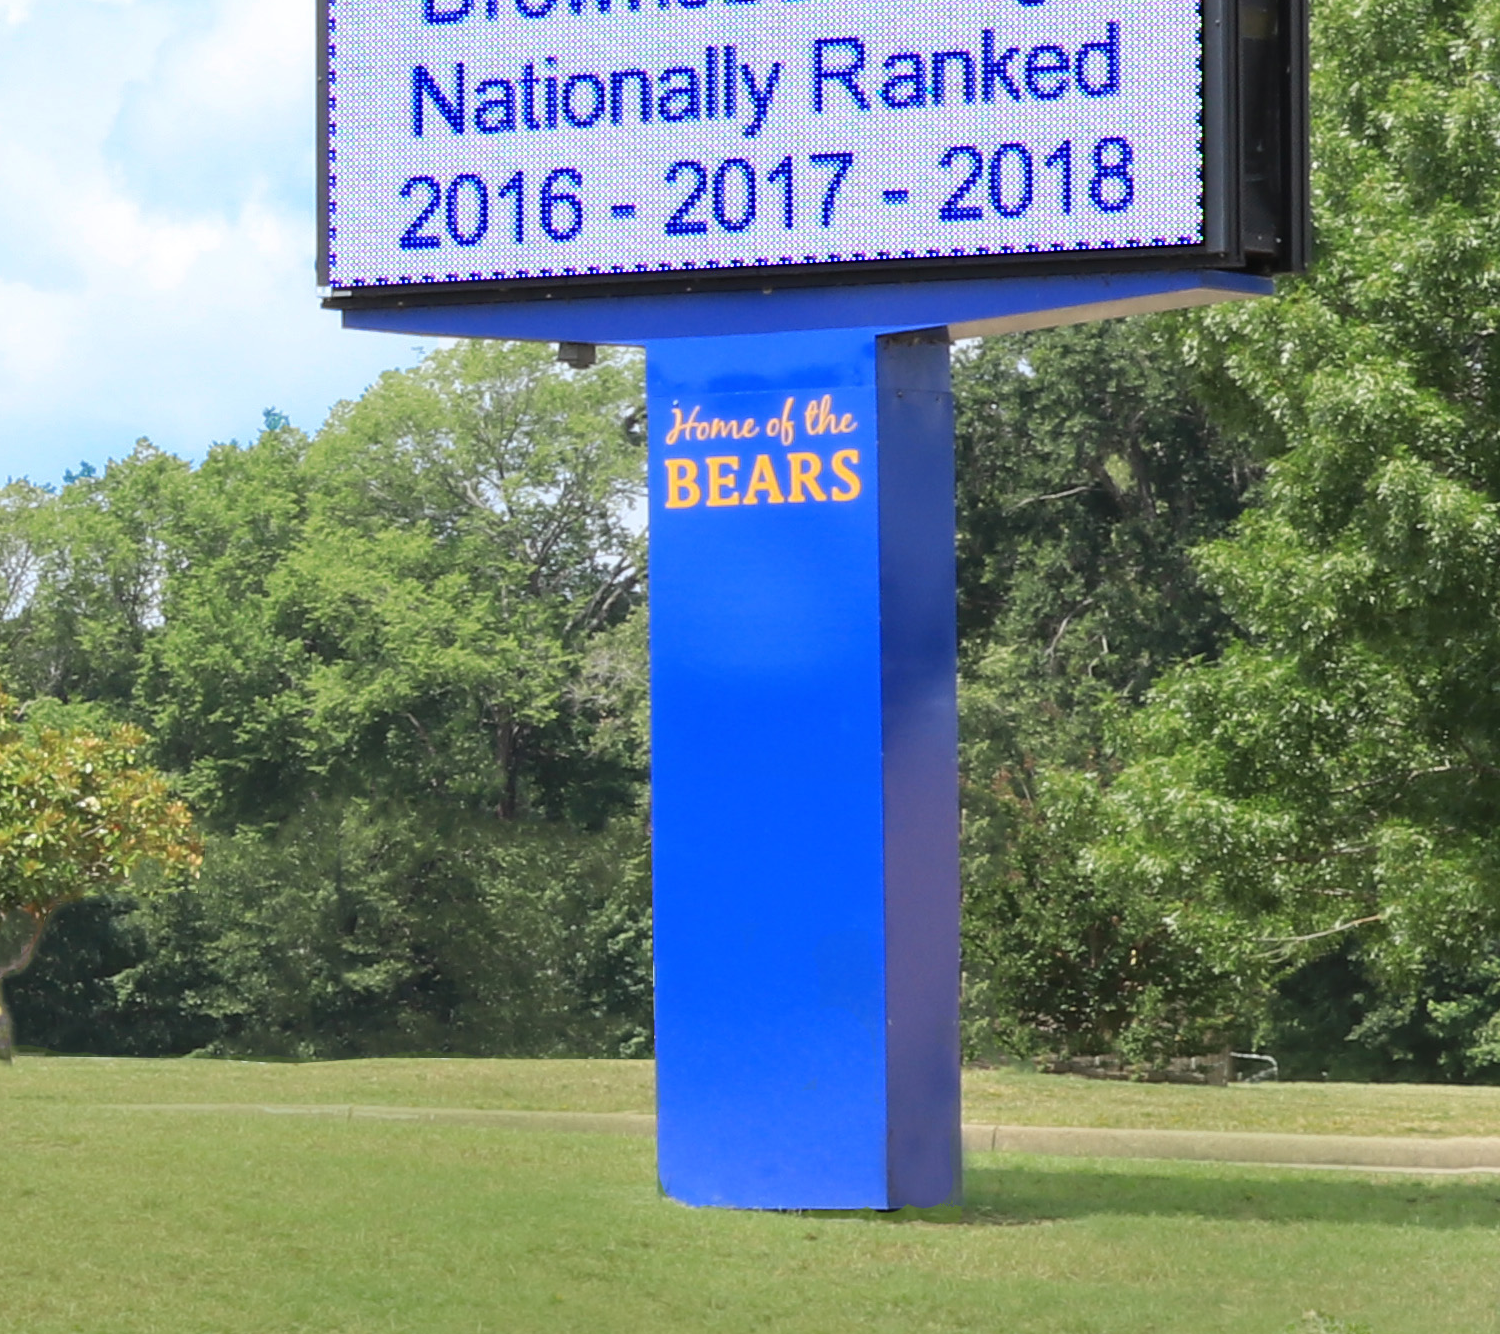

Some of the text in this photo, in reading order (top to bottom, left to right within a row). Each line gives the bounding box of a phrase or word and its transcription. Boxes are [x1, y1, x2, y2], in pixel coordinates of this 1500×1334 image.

[412, 21, 1121, 138] Nationally Ranked
[399, 167, 584, 250] 2016
[664, 151, 854, 236] 2017
[938, 137, 1135, 222] 2018
[665, 394, 858, 446] Home of the
[664, 448, 862, 509] BEARS
